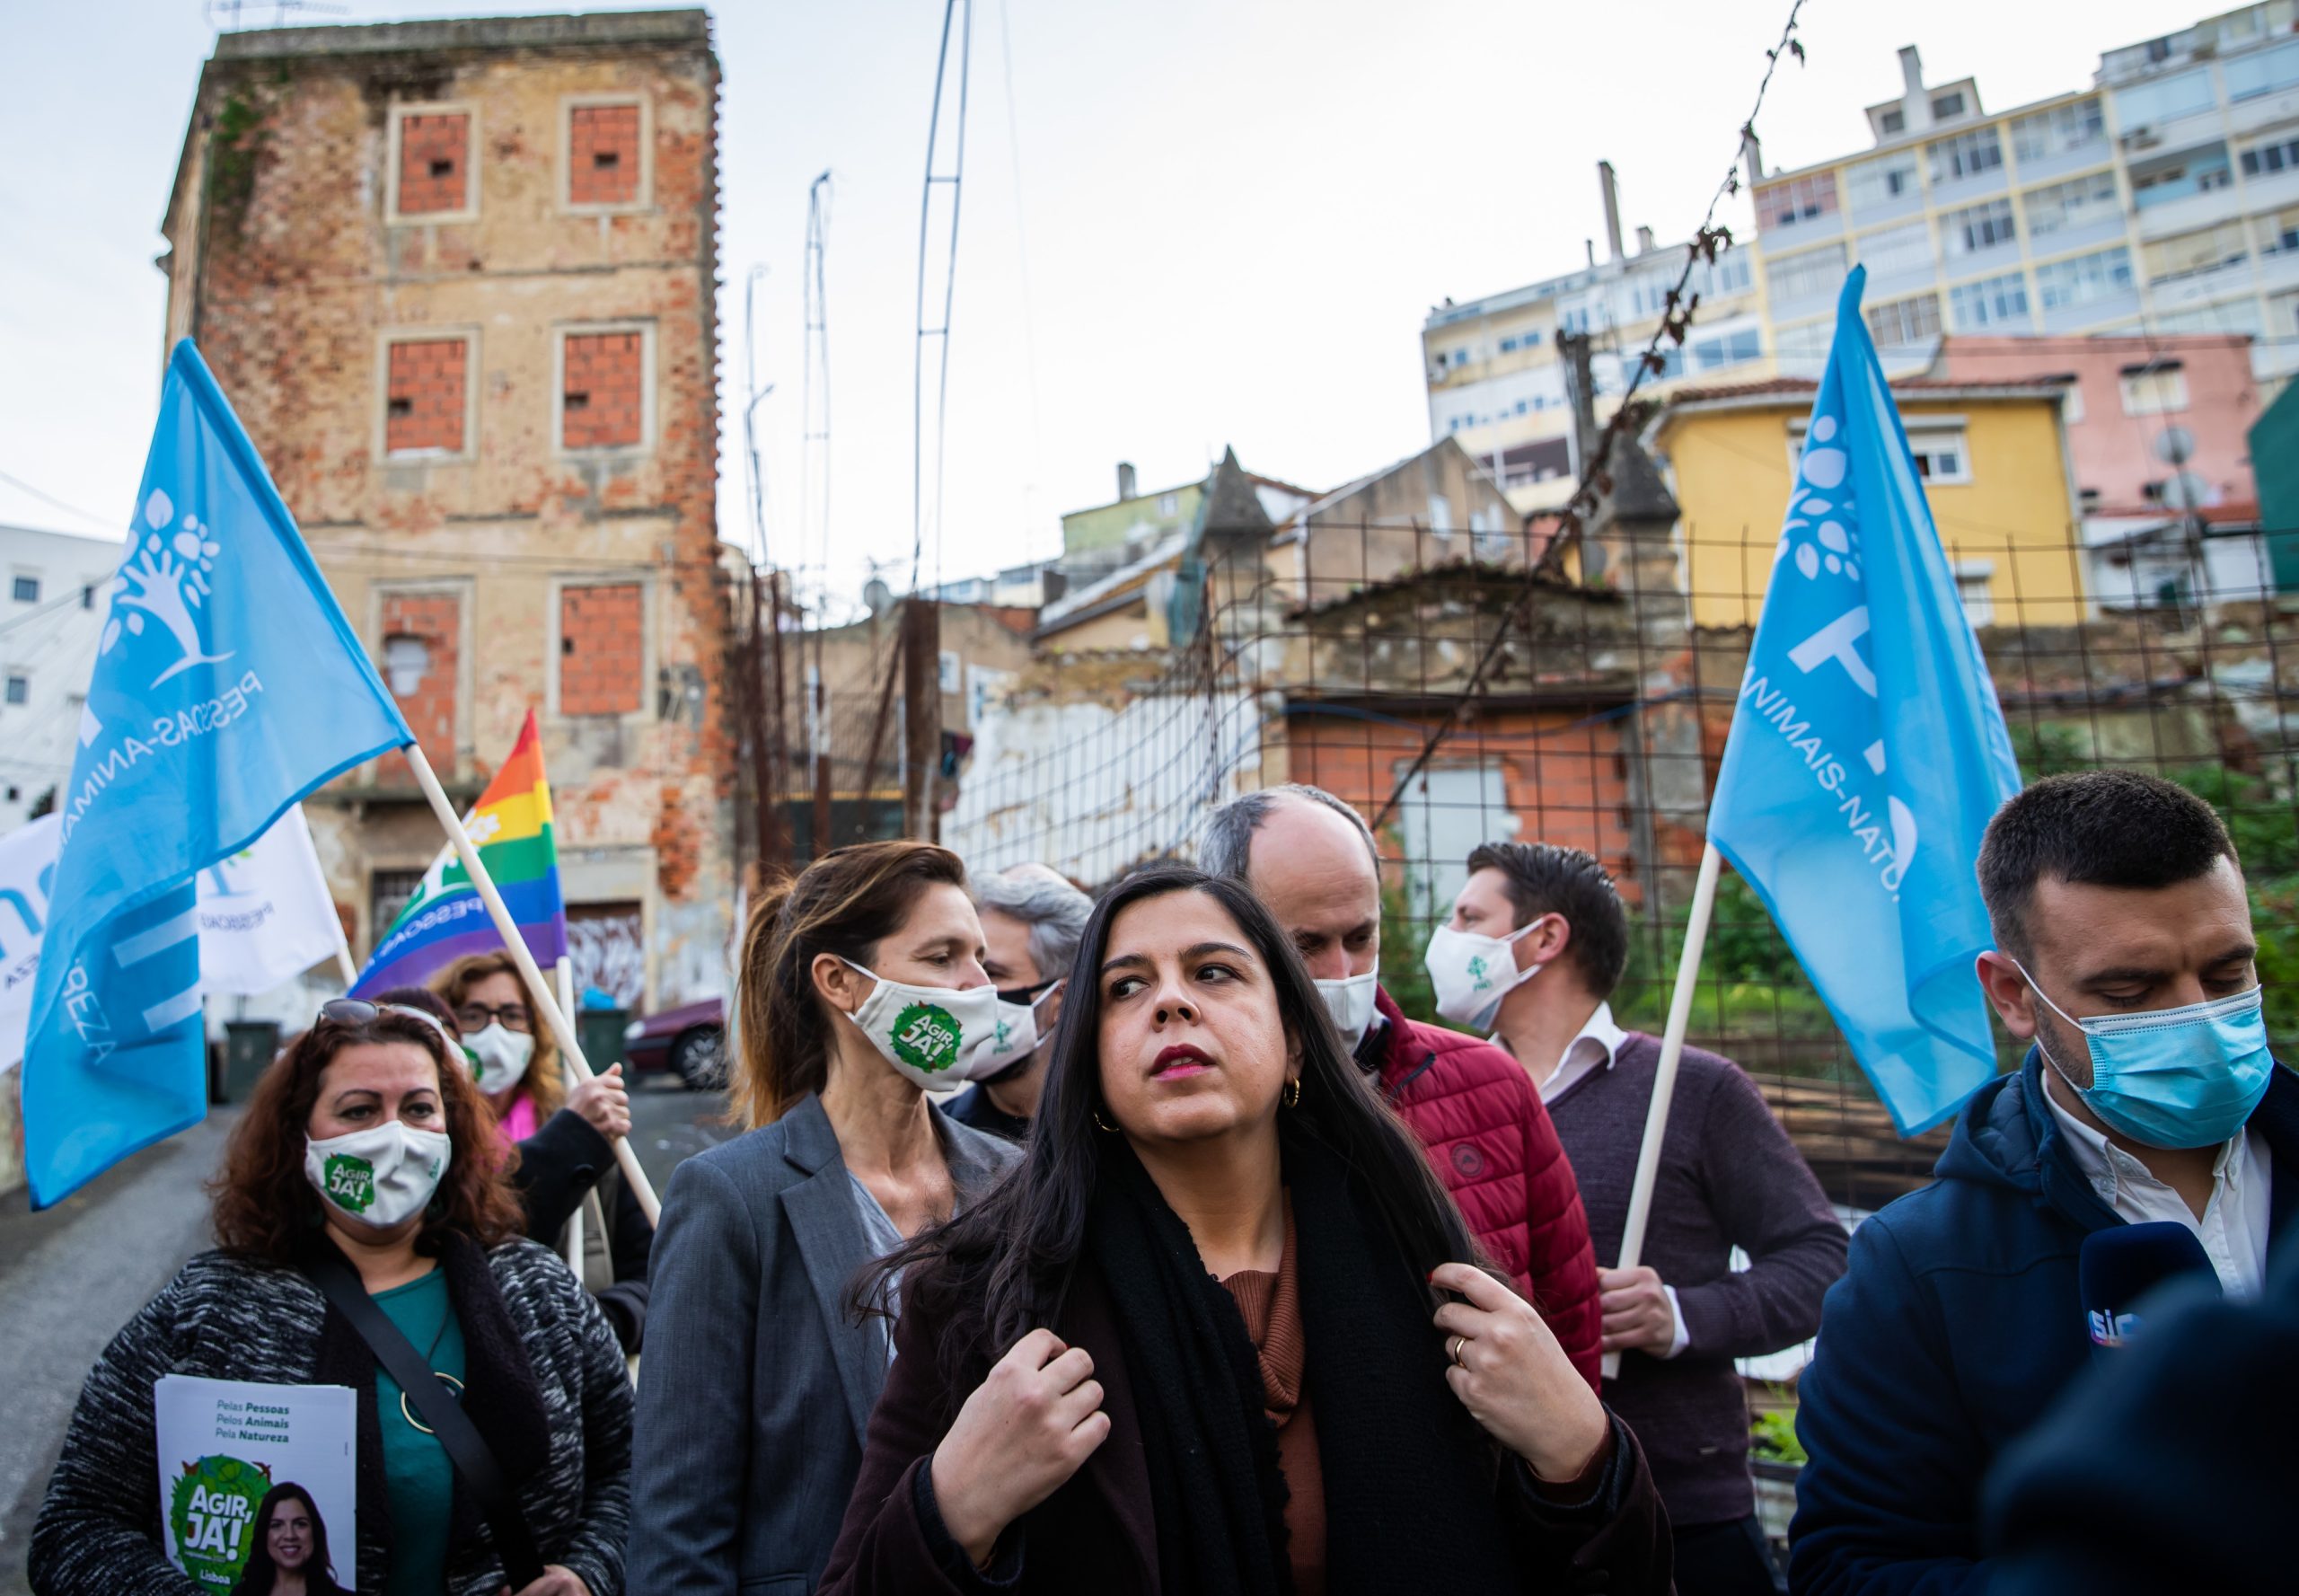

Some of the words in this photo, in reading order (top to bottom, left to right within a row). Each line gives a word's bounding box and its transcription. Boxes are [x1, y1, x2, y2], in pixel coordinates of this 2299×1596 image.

[1740, 665, 1901, 904] NIMAIS-NATU
[63, 957, 117, 1065] REZA
[898, 1024, 946, 1062] JÁ!
[912, 1014, 954, 1050] AGIR,
[216, 1399, 242, 1412] Pelas
[246, 1402, 289, 1415] Pessoas
[216, 1413, 242, 1425] Pelos
[245, 1416, 289, 1429] Animais
[215, 1426, 236, 1439] Pela
[239, 1430, 289, 1443] Natureza
[188, 1484, 253, 1524] AGIR,
[184, 1512, 243, 1562] JÁ!
[199, 1569, 231, 1586] Lisboa
